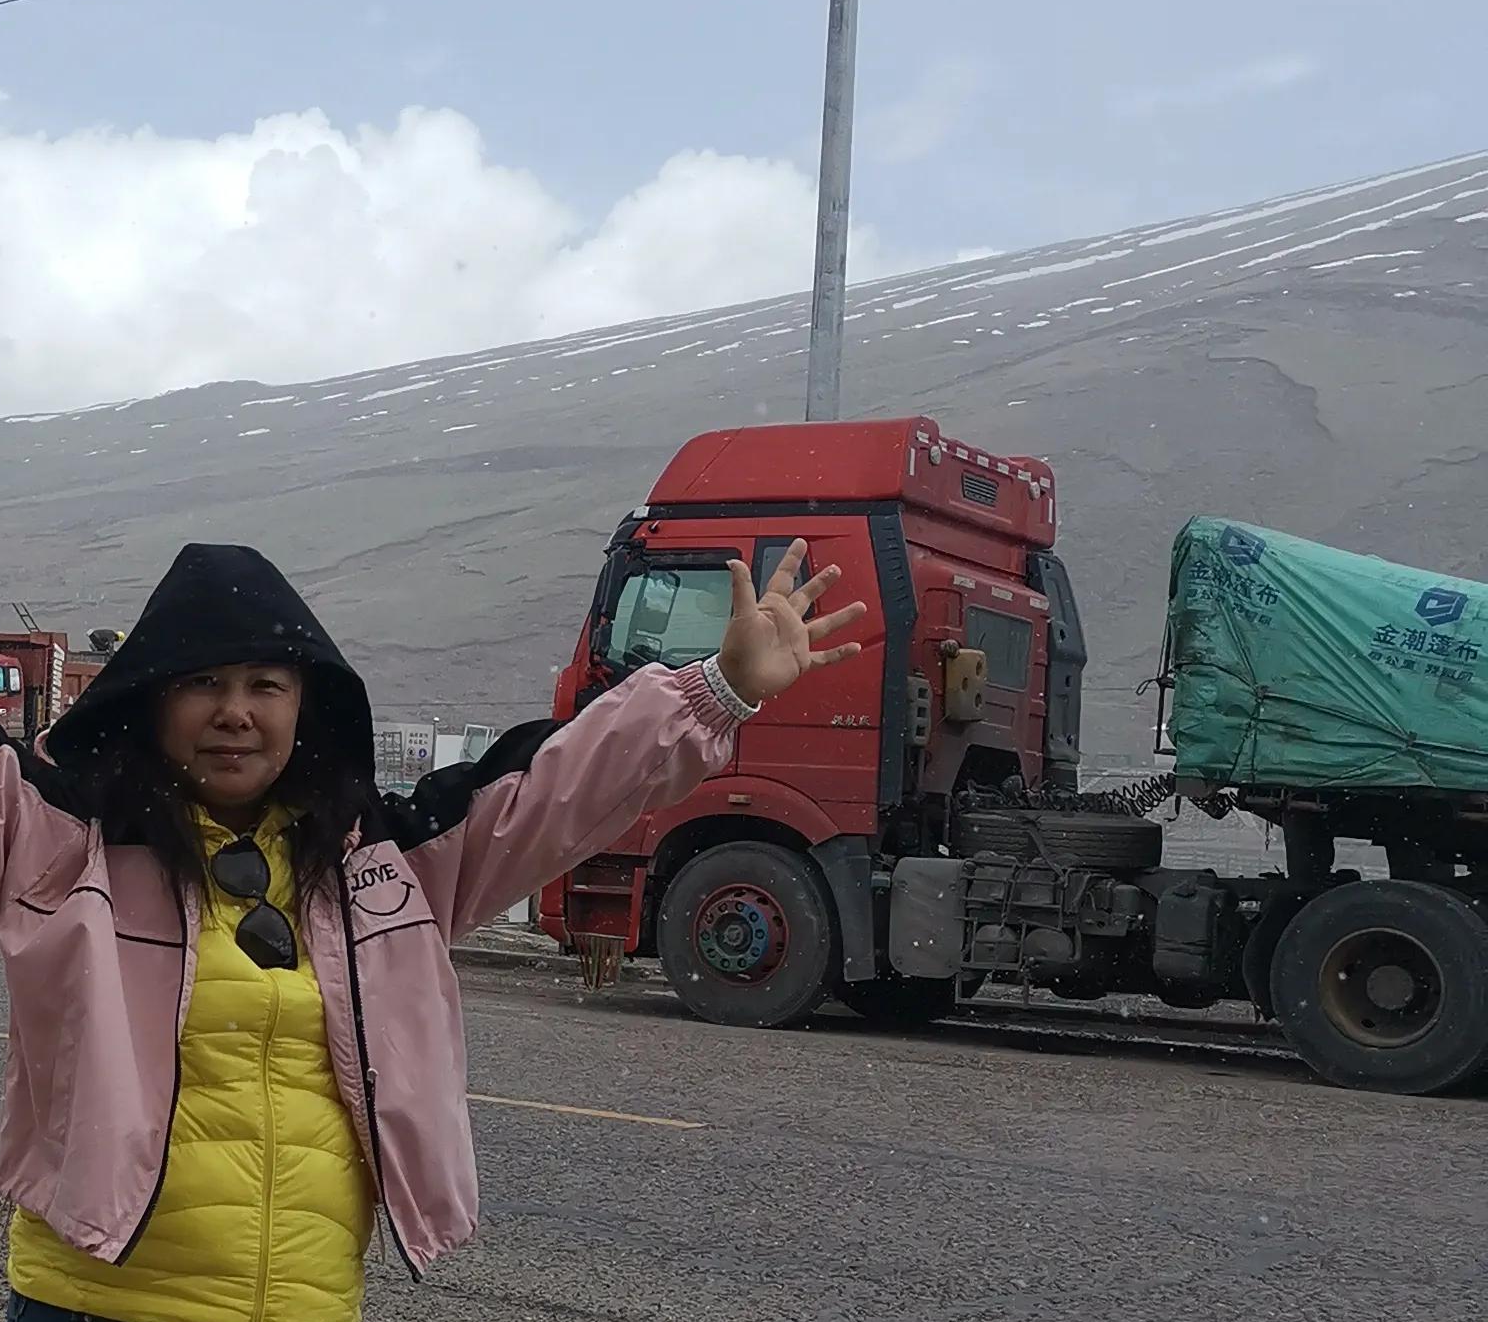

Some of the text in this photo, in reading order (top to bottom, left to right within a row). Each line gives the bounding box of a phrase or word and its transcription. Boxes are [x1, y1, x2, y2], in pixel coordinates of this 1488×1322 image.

[1373, 623, 1483, 662] 金潮篷布
[351, 863, 399, 893] LOVE
